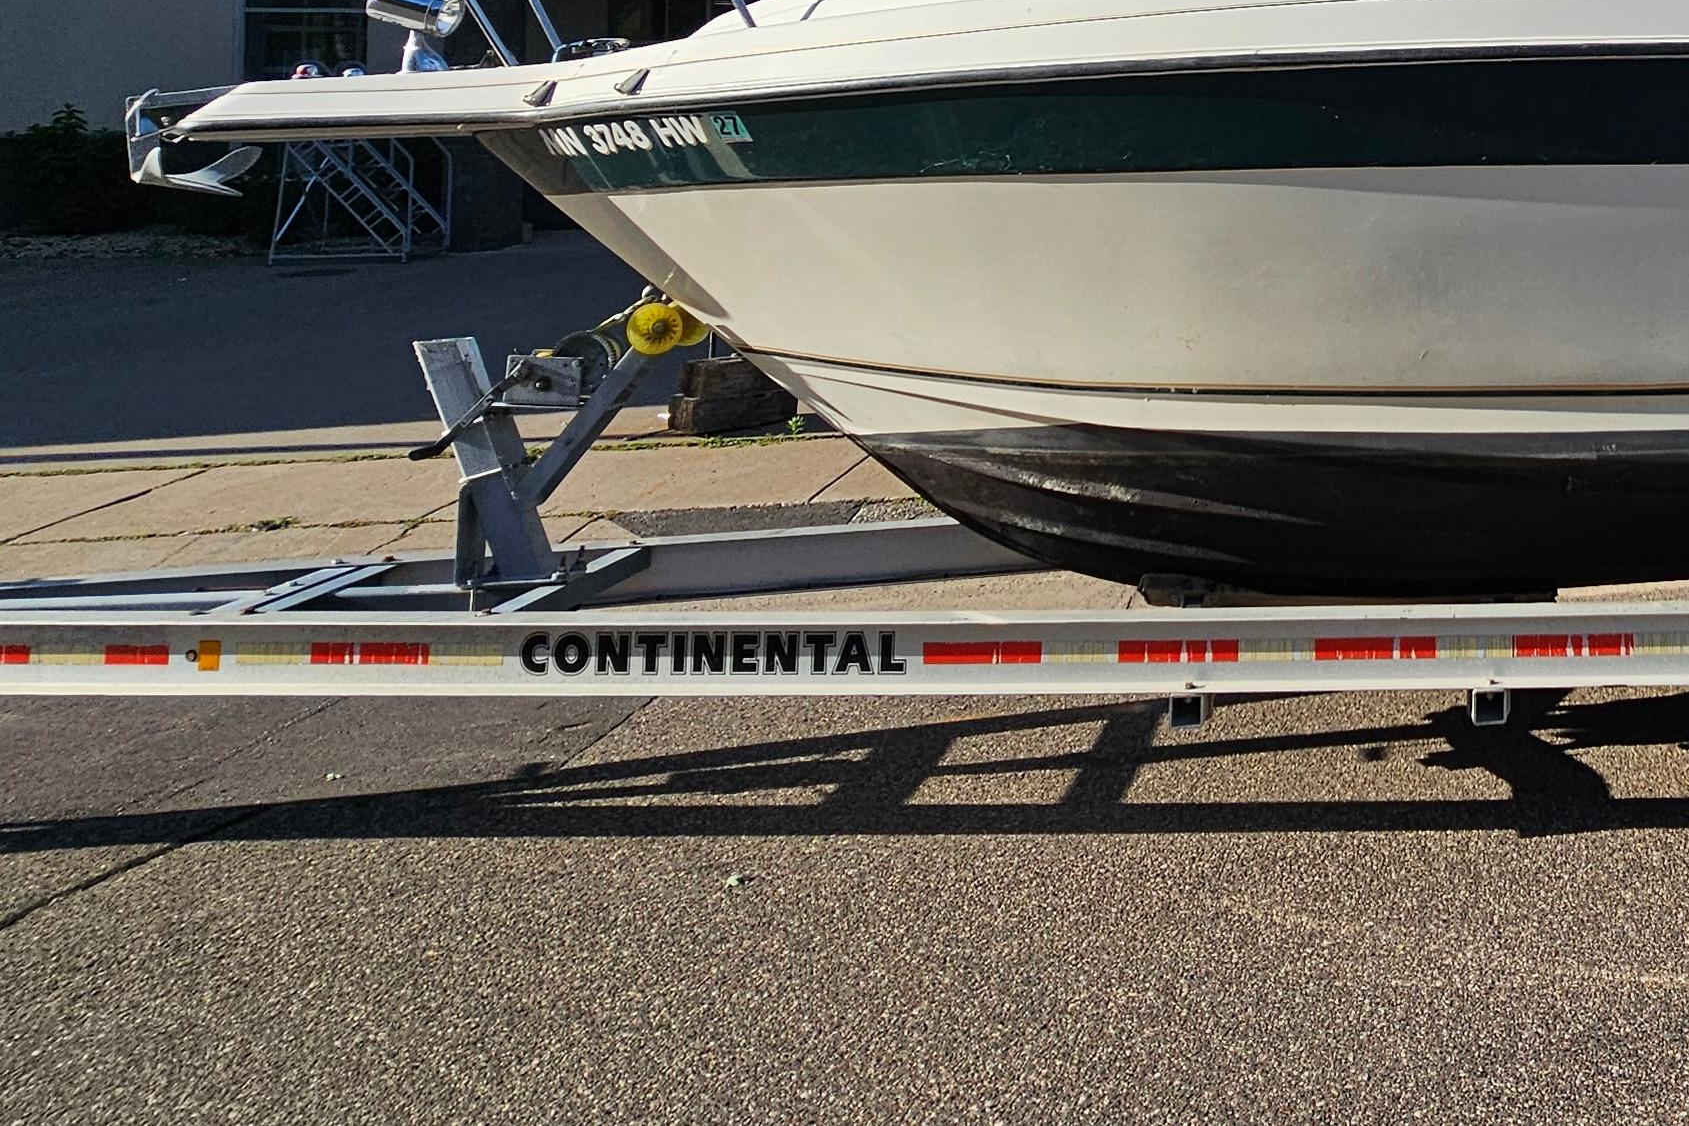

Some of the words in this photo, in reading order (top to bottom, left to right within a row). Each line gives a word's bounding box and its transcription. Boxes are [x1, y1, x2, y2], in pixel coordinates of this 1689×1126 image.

[583, 120, 653, 156] 3748
[649, 114, 708, 148] HW
[713, 115, 742, 137] 27
[519, 630, 907, 676] CONTINENTAL
